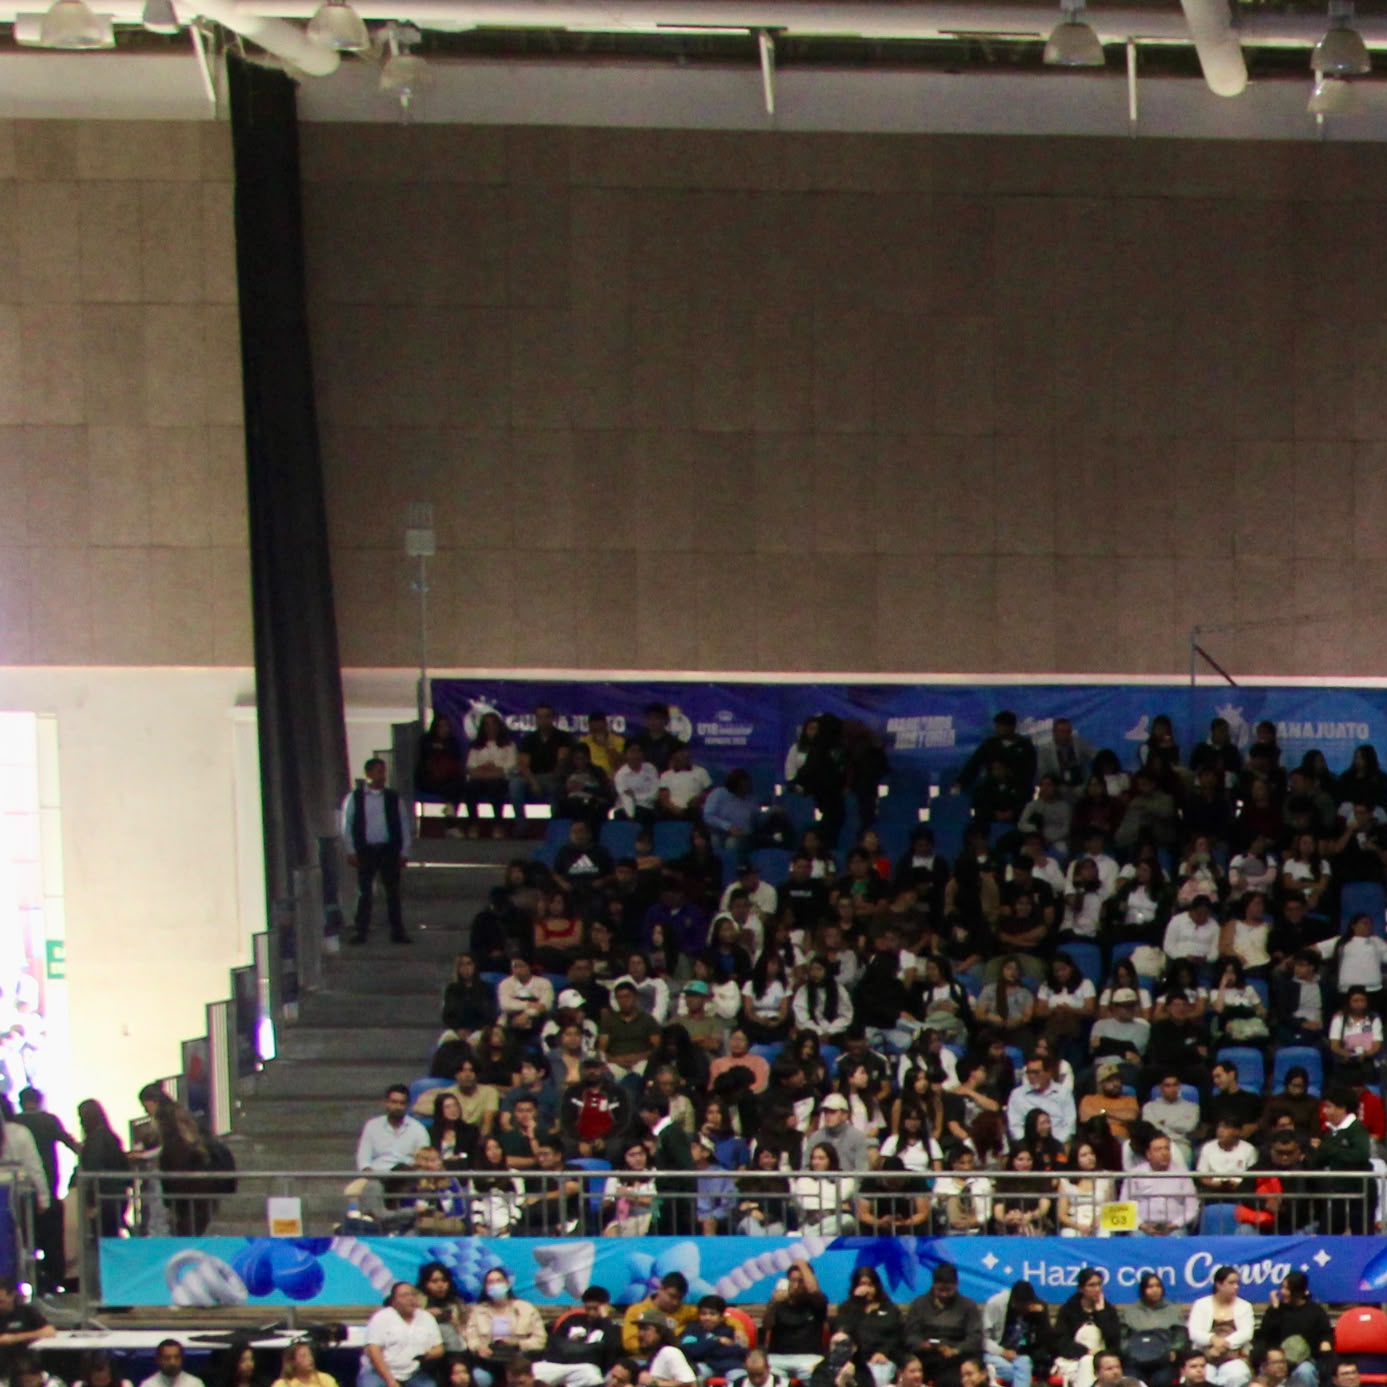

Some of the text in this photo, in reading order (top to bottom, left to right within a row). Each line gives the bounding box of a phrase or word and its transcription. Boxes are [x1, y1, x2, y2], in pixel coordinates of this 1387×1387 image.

[1251, 720, 1369, 739] ANAJUATO
[1023, 1261, 1109, 1287] Hazo
[1184, 1251, 1293, 1288] Cnva
